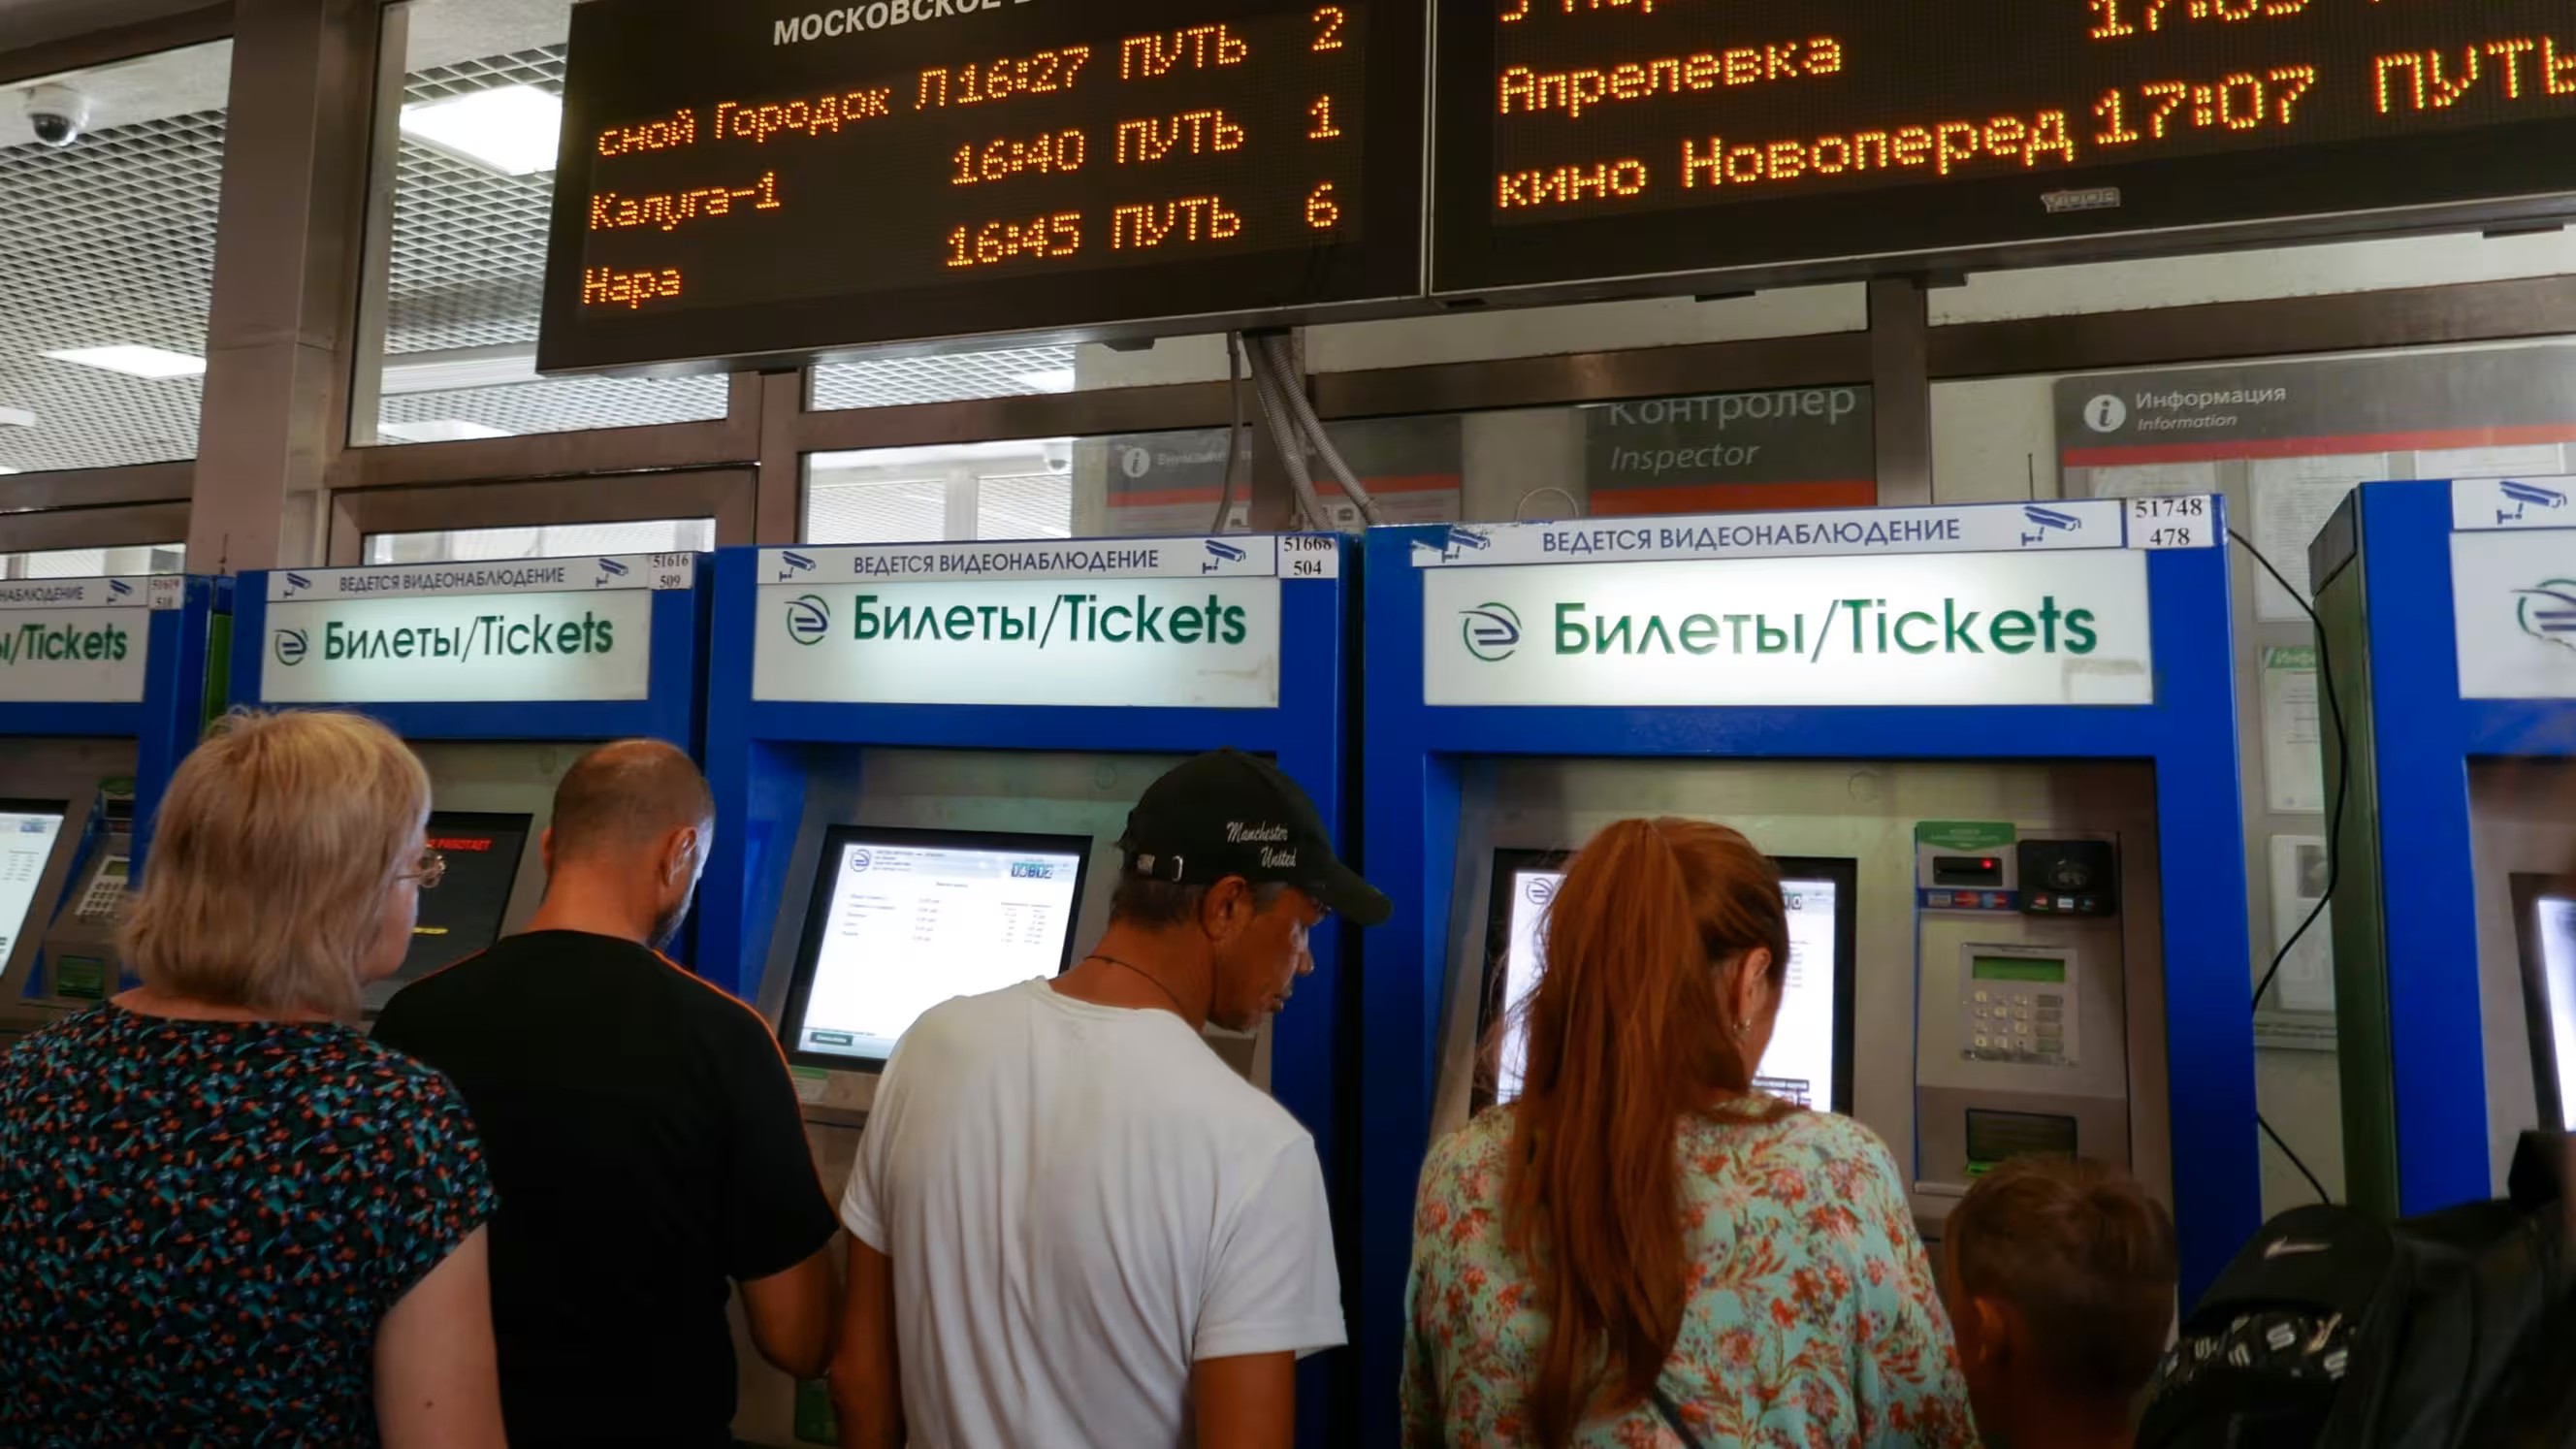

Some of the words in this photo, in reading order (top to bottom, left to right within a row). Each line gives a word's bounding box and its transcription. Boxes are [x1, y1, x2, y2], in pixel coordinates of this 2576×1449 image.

[598, 109, 694, 155] сной
[716, 88, 890, 143] Городок
[1121, 24, 1247, 80] ПУТЬ
[1311, 7, 1344, 52] 2
[1498, 37, 1842, 117] Апрелевка
[591, 171, 781, 231] Калуга-1
[952, 130, 1085, 185] 16:40
[1117, 110, 1244, 164] ПУТЬ
[1308, 95, 1341, 140] 1
[1498, 159, 1648, 209] кино
[583, 266, 681, 309] Нара
[947, 213, 1081, 267] 16:45
[1112, 197, 1241, 250] ПУТЬ
[1305, 182, 1338, 228] 6
[2135, 387, 2288, 412] Информация
[2137, 414, 2238, 432] Information
[1610, 443, 1761, 477] Inspector
[2135, 498, 2204, 519] 51748
[1283, 536, 1333, 552] 51668
[1543, 529, 1650, 555] ВЕДЕТСЯ
[1660, 518, 1961, 551] ВИДЕОНАБЛЮДЕНИЕ
[2149, 526, 2191, 547] 478
[653, 554, 690, 568] 51616
[853, 555, 935, 577] ВЕДЕТСЯ
[939, 549, 1159, 574] ВИДЕОНАБЛЮДЕНИЕ
[1293, 560, 1322, 575] 504
[339, 574, 401, 593] ВЕДЕТСЯ
[402, 566, 565, 592] ВИДЕОНАБЛЮДЕНИЕ
[660, 574, 682, 588] 509
[853, 594, 1247, 649] Билеты/Tickets
[1555, 595, 2098, 664] Билеты/Tickets
[324, 611, 615, 663] Билеты/Tickets
[1226, 820, 1288, 843] Manchester
[1261, 846, 1298, 868] United
